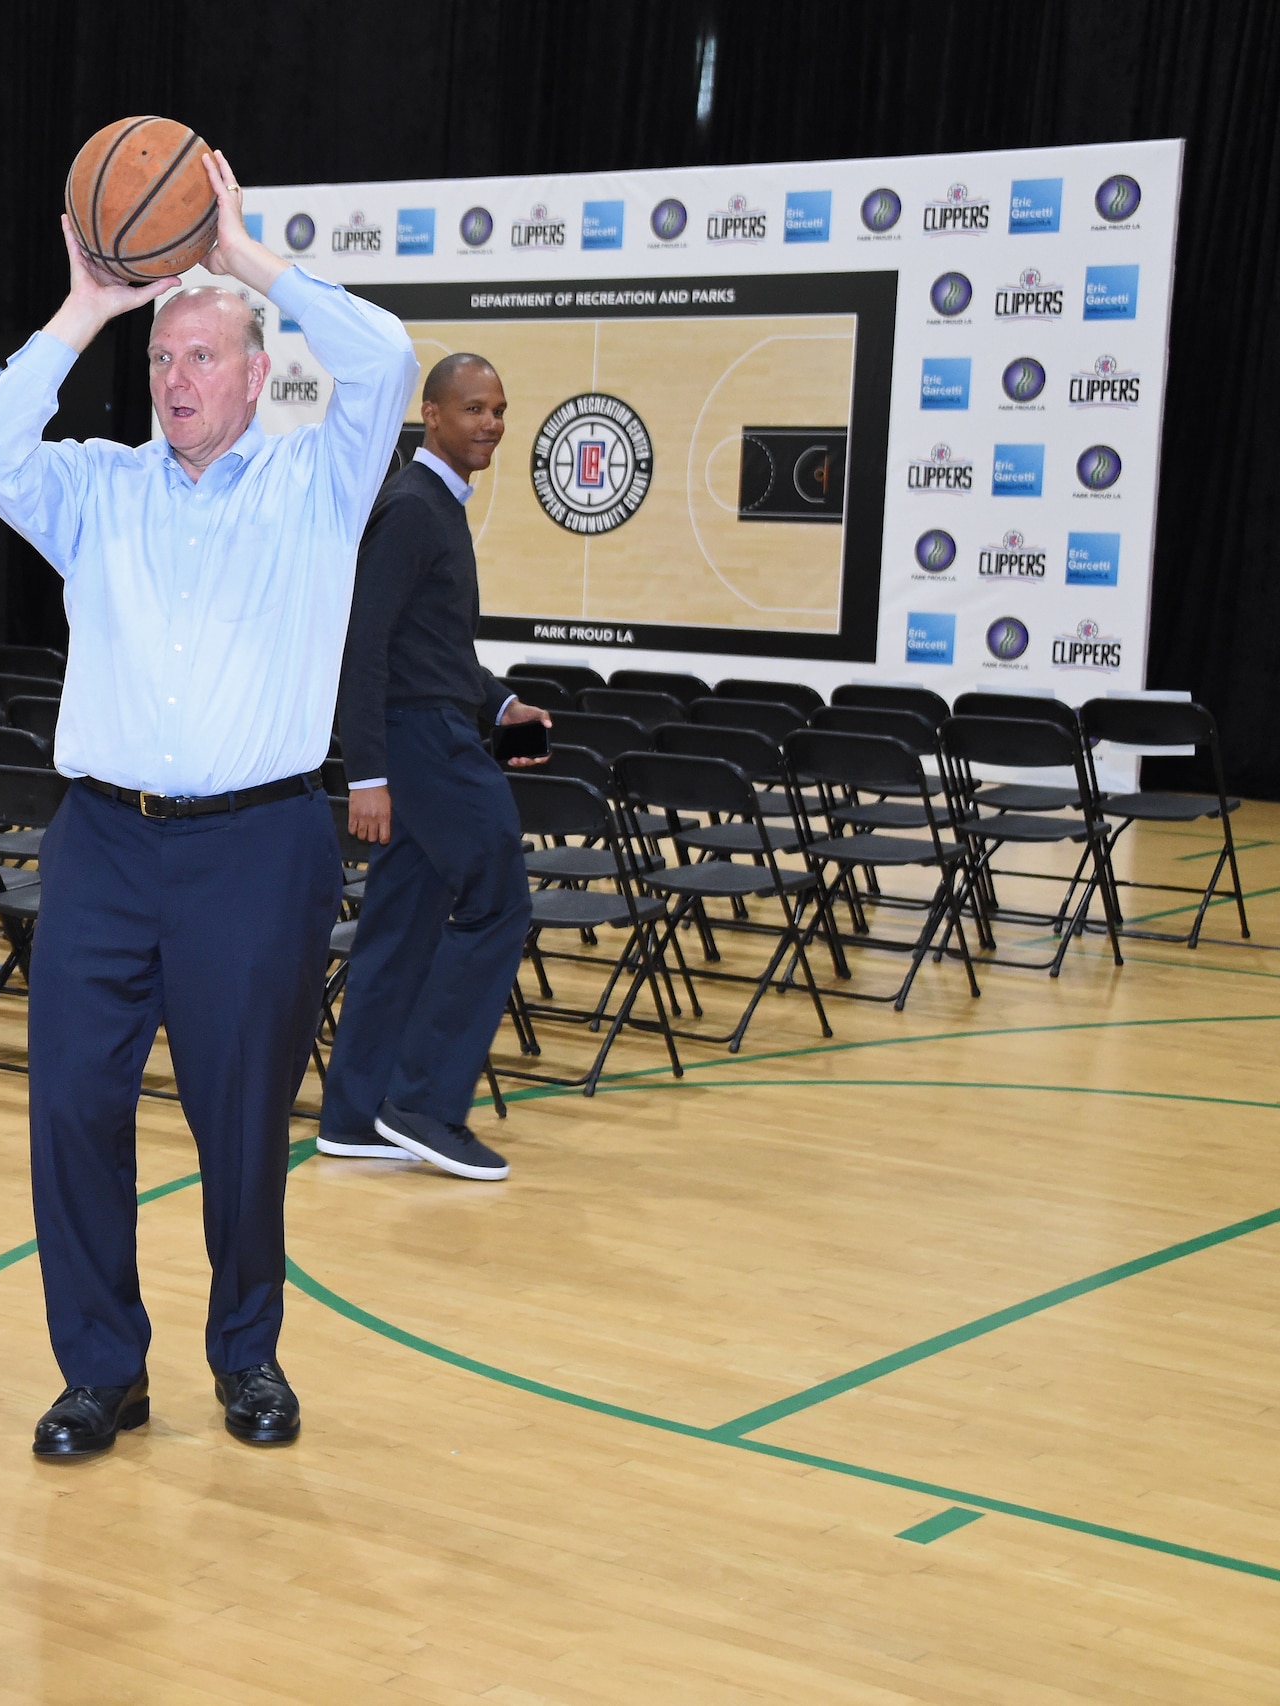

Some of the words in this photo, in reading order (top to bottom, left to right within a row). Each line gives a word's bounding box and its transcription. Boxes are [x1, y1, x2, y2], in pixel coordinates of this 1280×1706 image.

[1012, 197, 1031, 207] Eric
[923, 205, 989, 231] CLIPPERS
[1011, 207, 1053, 219] Garcetti
[511, 224, 565, 247] CLIPPERS
[707, 215, 766, 240] CLIPPERS
[332, 230, 381, 252] CLIPPERS
[470, 293, 552, 308] DEPARTMENT
[554, 292, 573, 306] OF
[575, 291, 655, 306] RECREATION
[658, 290, 688, 304] AND
[691, 288, 735, 303] PARKS
[1086, 293, 1129, 305] Garcetti
[1087, 283, 1107, 294] Eric
[995, 290, 1063, 316] CLIPPERS
[922, 385, 962, 396] Garcetti
[923, 375, 941, 385] Eric
[1069, 378, 1140, 403] CLIPPERS
[271, 381, 318, 402] CLIPPERS
[542, 401, 577, 438] GILLIAM
[577, 396, 633, 425] RECREATION
[535, 435, 551, 459] JIM
[625, 419, 649, 460] CENTER
[995, 460, 1014, 471] Eric
[908, 465, 973, 489] CLIPPERS
[994, 471, 1035, 482] Garcetti
[533, 469, 566, 522] CLIPPERS
[564, 503, 628, 533] COMMUNITY
[622, 471, 648, 511] COURT
[1069, 548, 1089, 559] Eric
[978, 552, 1046, 577] CLIPPERS
[1068, 560, 1110, 571] Garcetti
[534, 624, 566, 639] PARK
[569, 626, 615, 642] PROUD
[616, 629, 634, 643] LA
[908, 628, 927, 639] Eric
[907, 640, 947, 650] Garcetti
[1052, 640, 1121, 667] CLIPPERS
